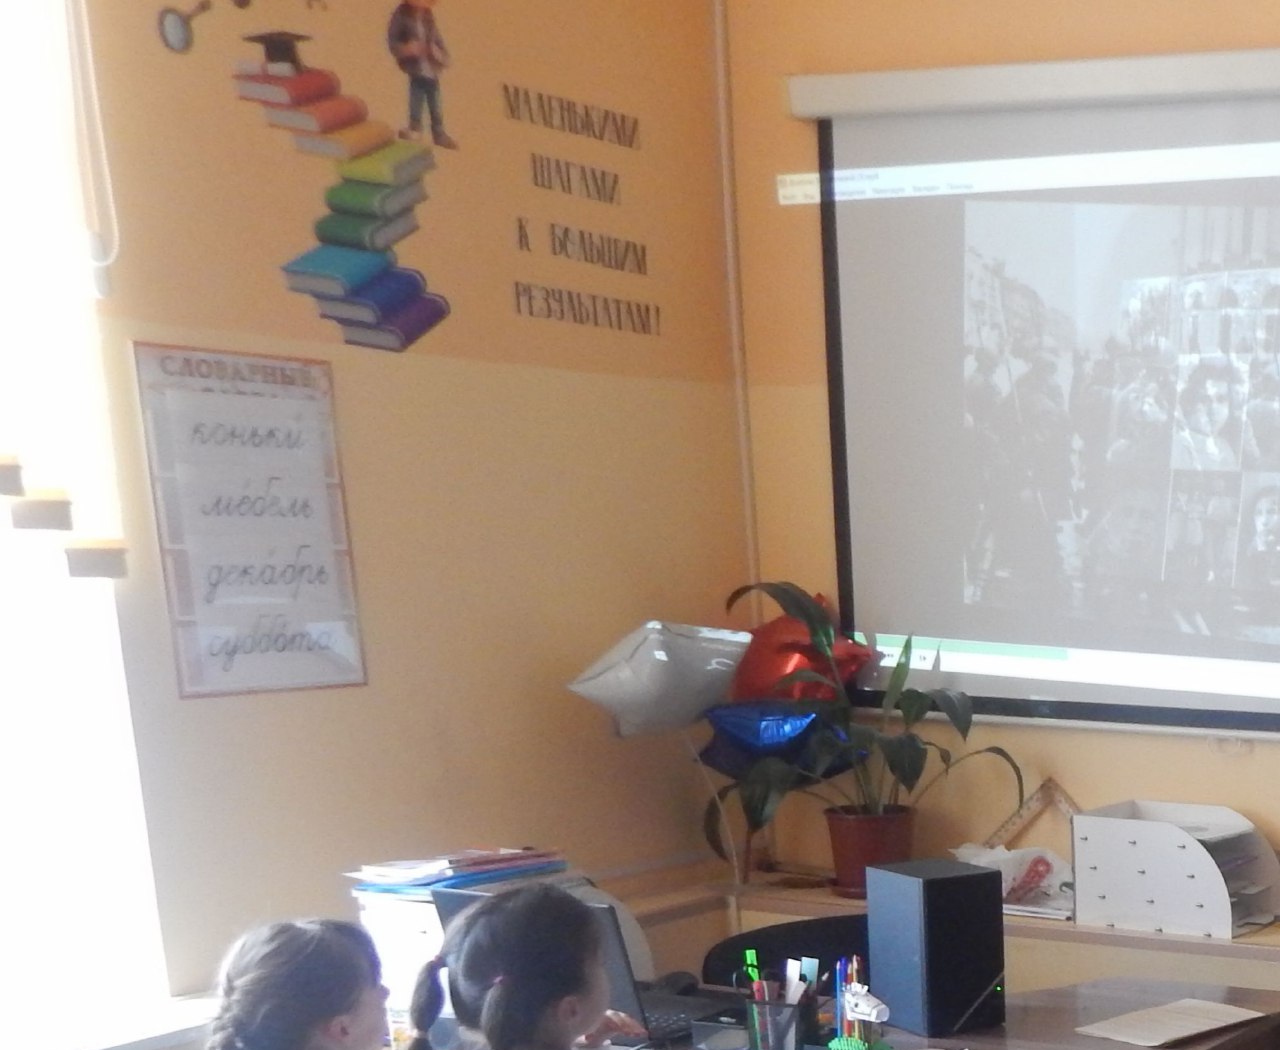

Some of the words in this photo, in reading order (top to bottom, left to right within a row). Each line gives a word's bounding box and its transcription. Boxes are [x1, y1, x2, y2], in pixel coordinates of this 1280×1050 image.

[531, 152, 620, 206] ШАГАМИ
[517, 217, 531, 252] К
[550, 222, 647, 275] БОЛЬШИМ
